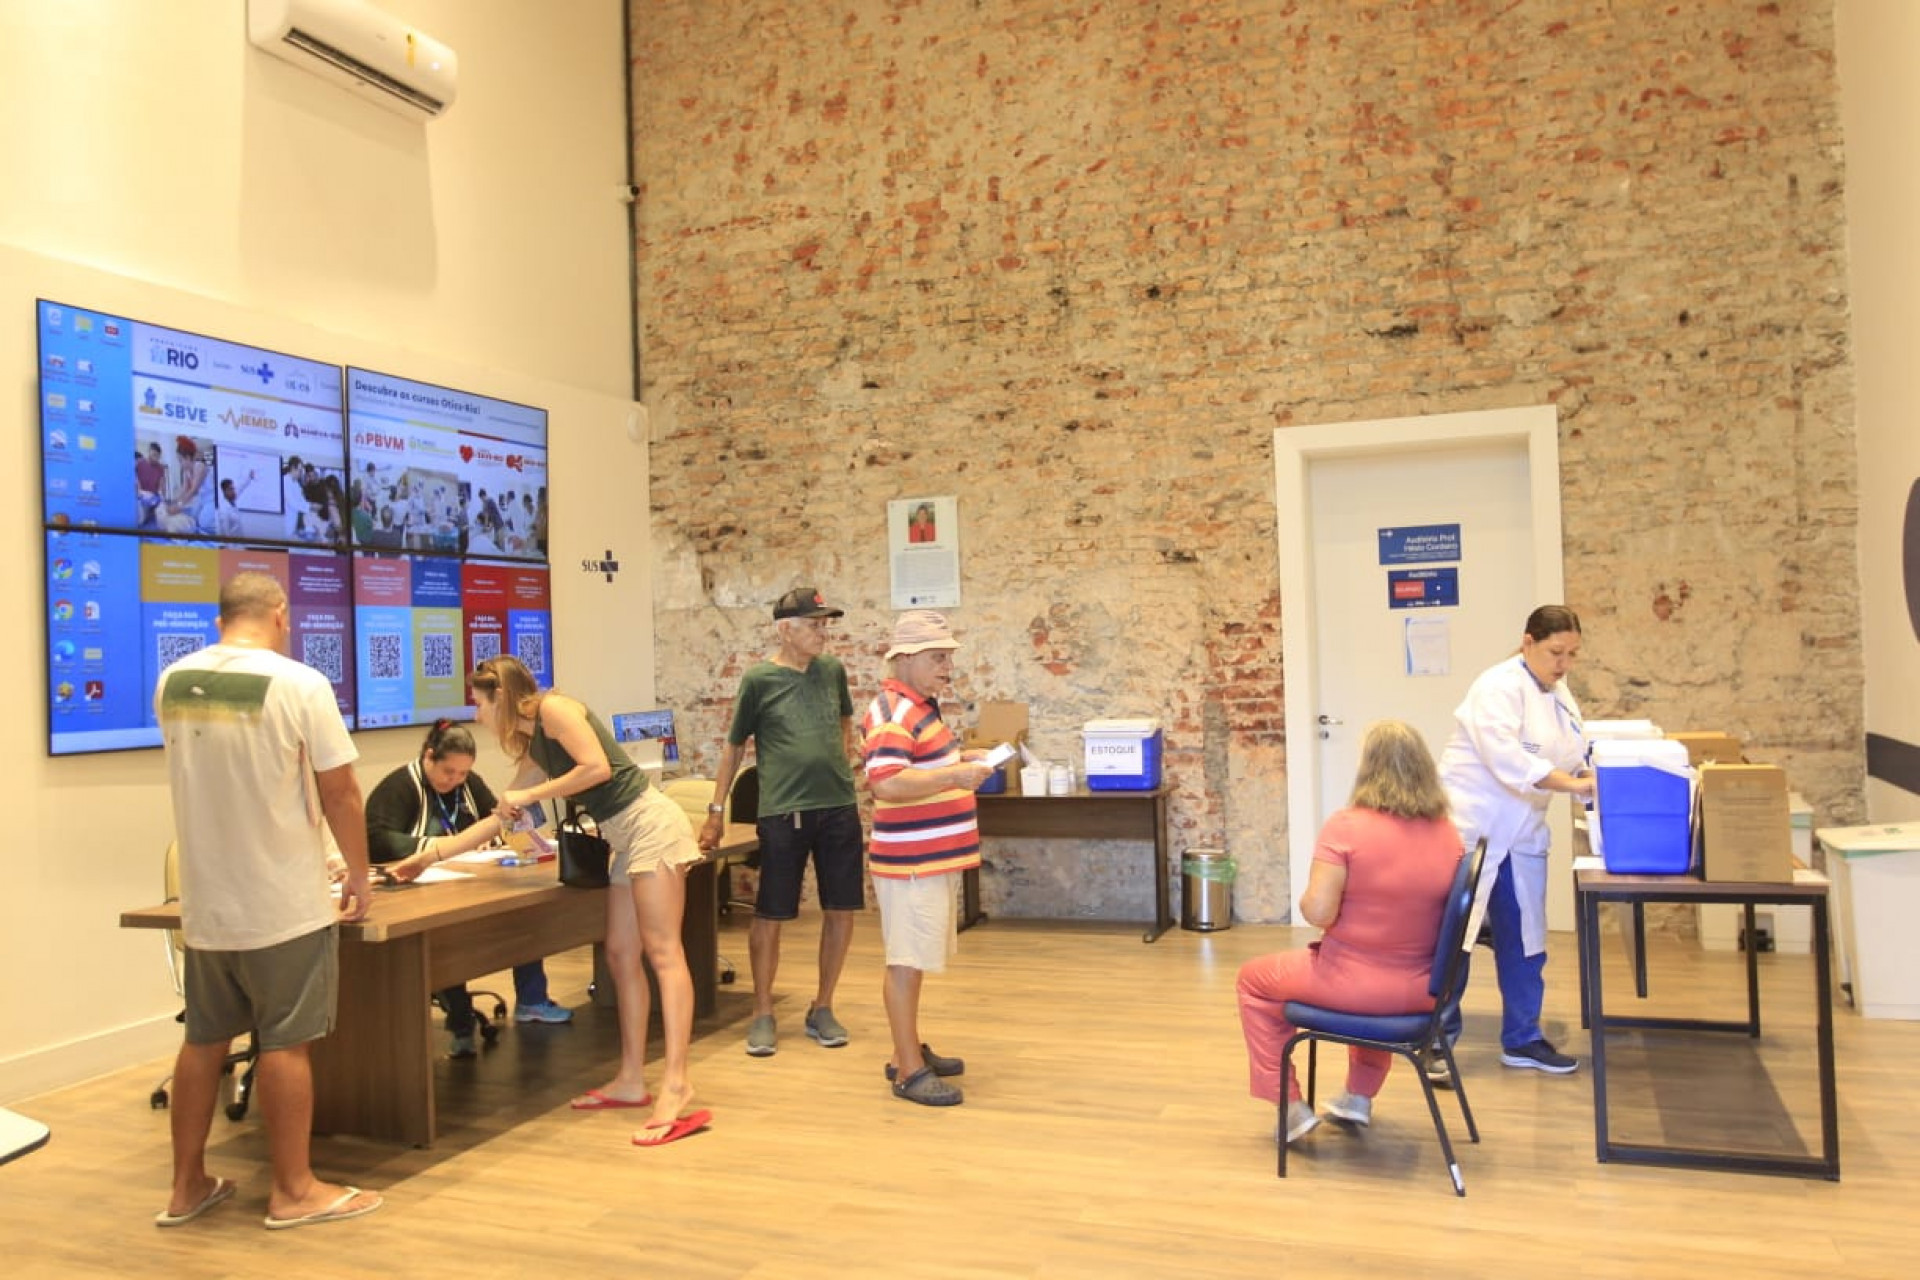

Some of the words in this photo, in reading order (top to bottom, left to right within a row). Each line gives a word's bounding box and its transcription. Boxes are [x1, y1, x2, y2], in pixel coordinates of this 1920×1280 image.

[167, 348, 199, 370] RIO
[355, 380, 398, 398] Descubra
[399, 391, 410, 400] os
[412, 394, 440, 406] cursos
[164, 402, 208, 423] SBVE
[366, 432, 404, 452] PBVM
[581, 559, 599, 572] SUS
[1090, 745, 1137, 755] ESTOQUE
